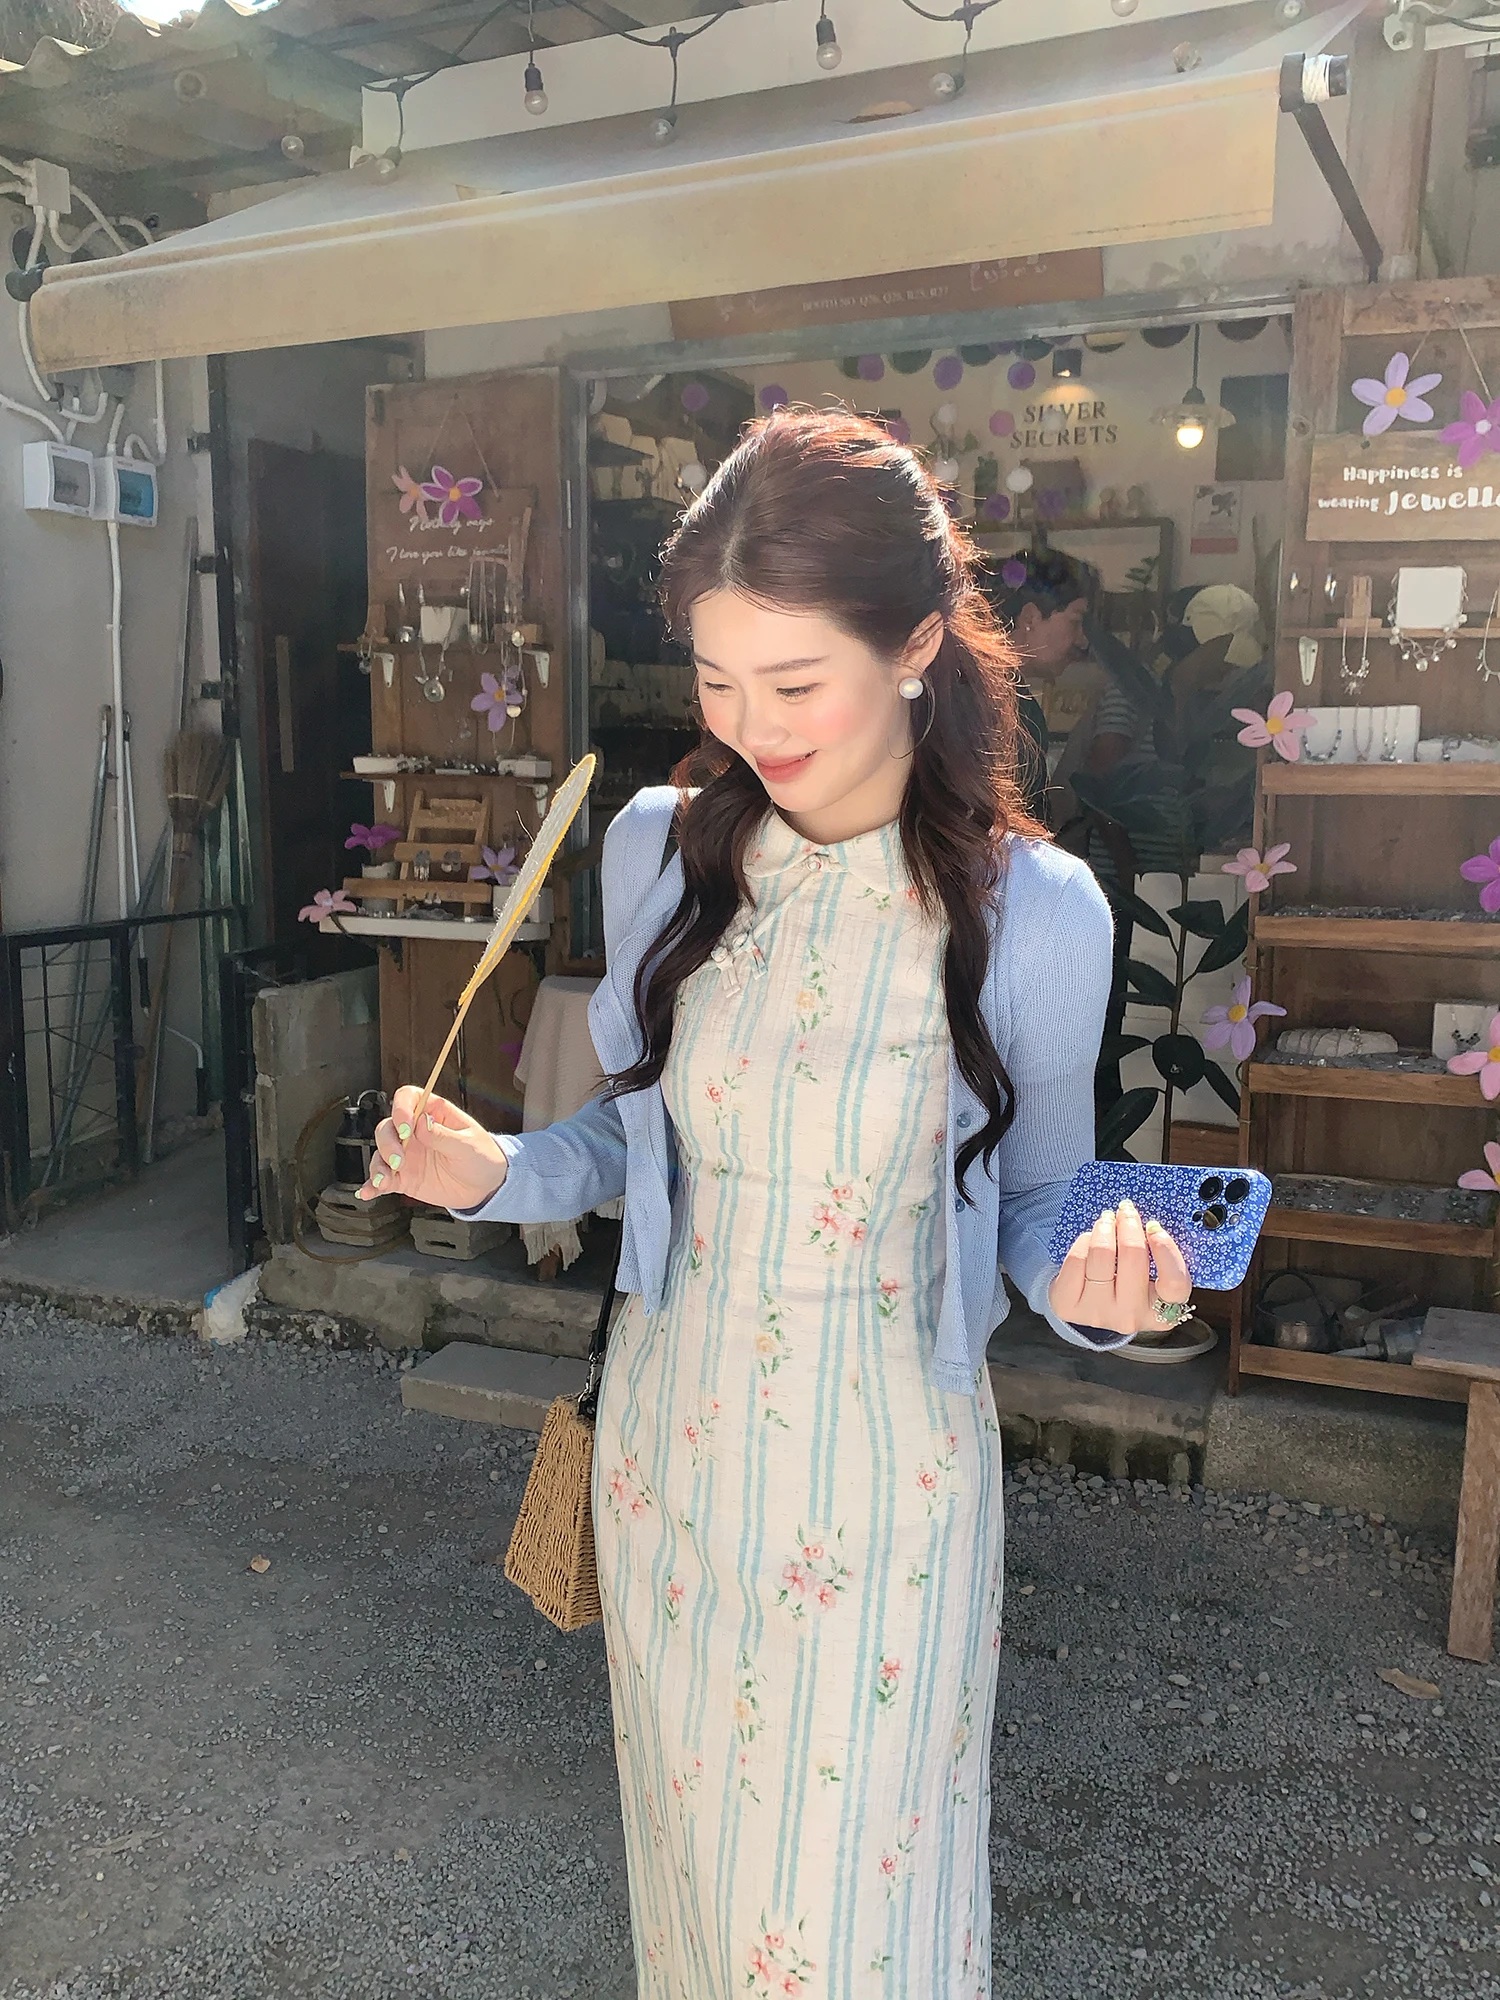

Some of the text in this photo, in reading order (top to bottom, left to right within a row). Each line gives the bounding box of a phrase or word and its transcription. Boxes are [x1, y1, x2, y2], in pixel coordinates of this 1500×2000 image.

[1024, 401, 1106, 423] SIVER
[1010, 424, 1118, 449] SECRETS
[1343, 464, 1463, 485] Happiness is
[1318, 496, 1380, 512] wearing
[421, 549, 443, 565] you
[447, 545, 468, 557] like
